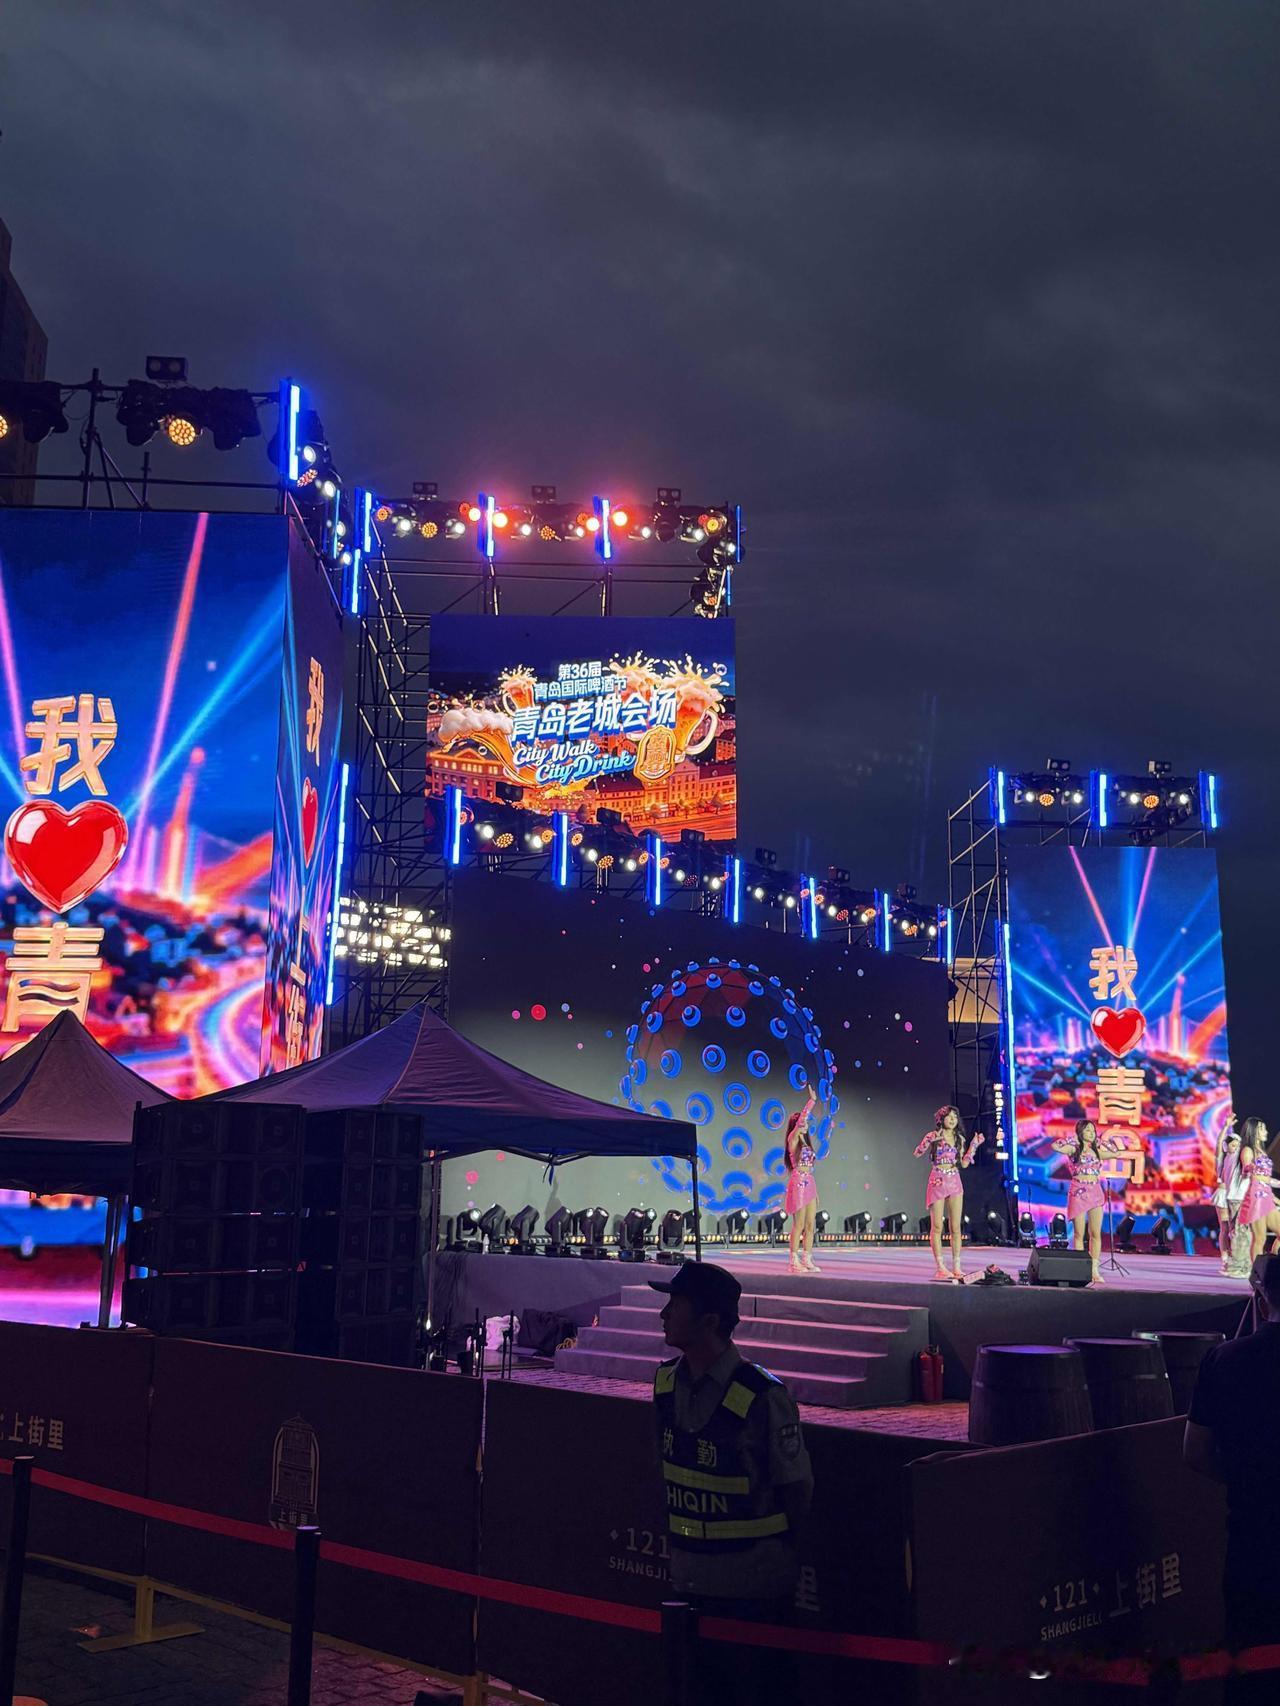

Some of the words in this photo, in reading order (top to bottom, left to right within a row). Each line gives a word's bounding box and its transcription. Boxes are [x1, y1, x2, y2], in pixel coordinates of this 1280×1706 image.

[534, 675, 627, 701] 青岛国际啤酒节
[558, 661, 602, 681] 第36届
[511, 688, 678, 742] 青岛老城会场
[21, 693, 118, 796] 我
[513, 746, 549, 766] City
[549, 740, 597, 762] Walk
[535, 762, 574, 785] City
[572, 750, 637, 776] Drink
[1089, 945, 1138, 1001] 我
[8, 1411, 64, 1451] 上街里
[608, 1556, 672, 1583] SHANGJI
[1108, 1552, 1183, 1618] 上街里
